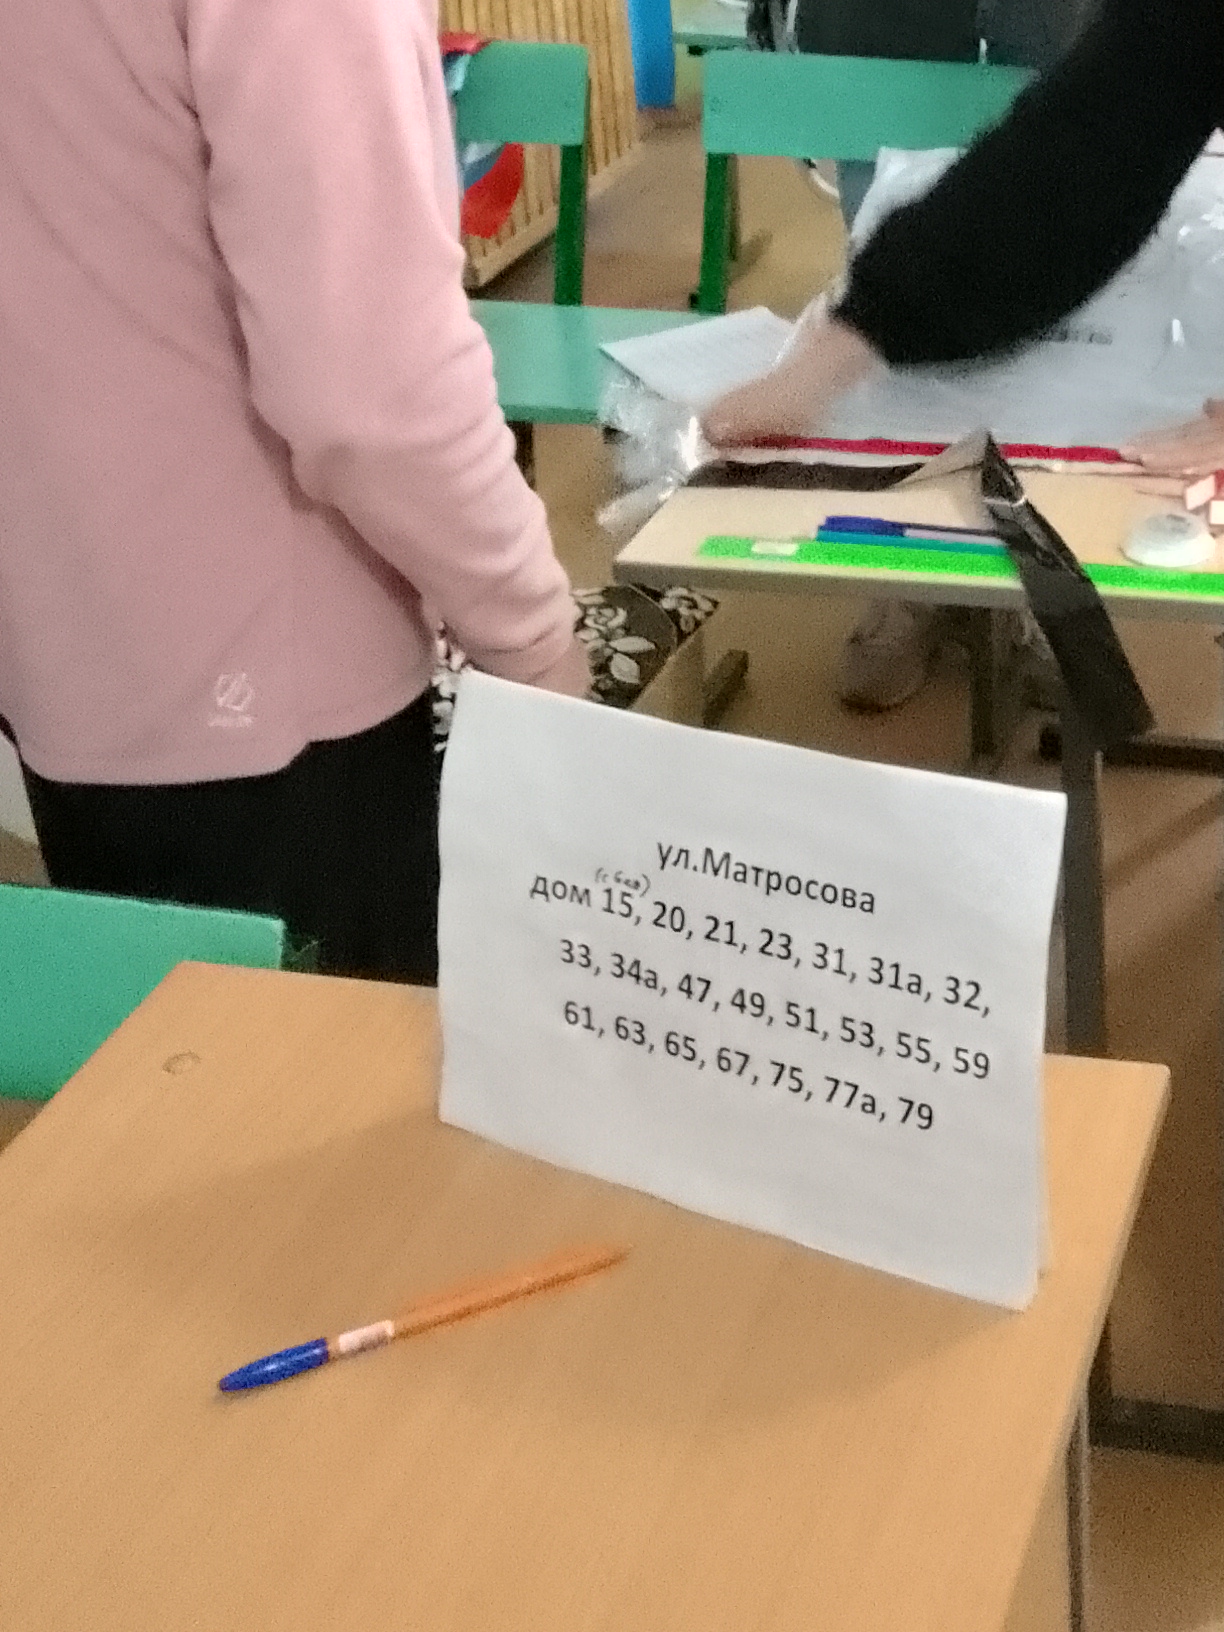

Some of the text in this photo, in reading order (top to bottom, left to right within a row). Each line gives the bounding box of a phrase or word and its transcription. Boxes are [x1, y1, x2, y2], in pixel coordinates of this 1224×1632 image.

[529, 874, 991, 1019] дом 15, 20, 21, 23, 31, 31а, 32,
[656, 842, 876, 915] ул.Матросова
[560, 938, 991, 1080] 33, 34а, 47, 49, 51, 53, 55, 59
[563, 1000, 935, 1131] 61, 63, 65, 67, 75, 77а, 79
